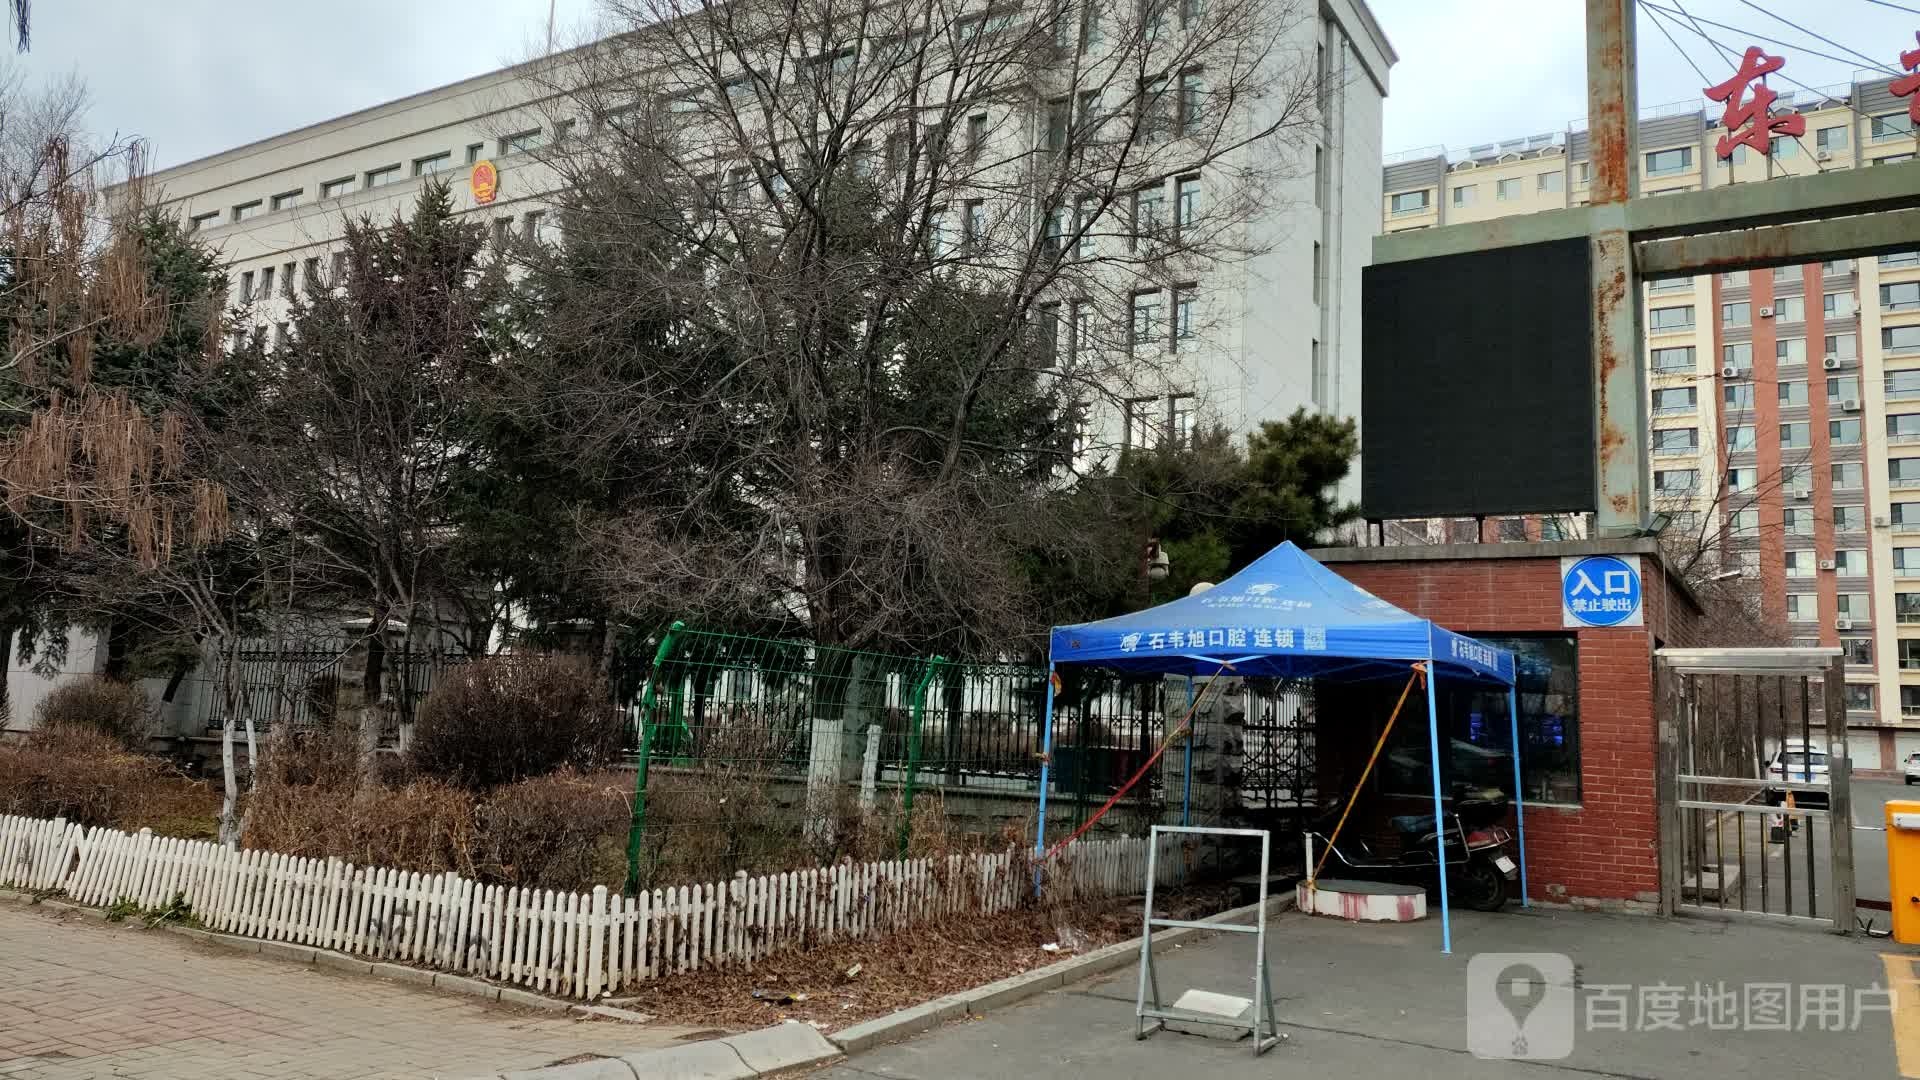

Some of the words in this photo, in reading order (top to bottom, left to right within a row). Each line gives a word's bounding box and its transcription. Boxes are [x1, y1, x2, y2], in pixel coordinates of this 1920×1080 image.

[1570, 569, 1630, 596] 入口
[1572, 598, 1631, 612] 禁止驶出
[1148, 629, 1246, 650] 石韦旭口腔
[1254, 628, 1294, 648] 连锁
